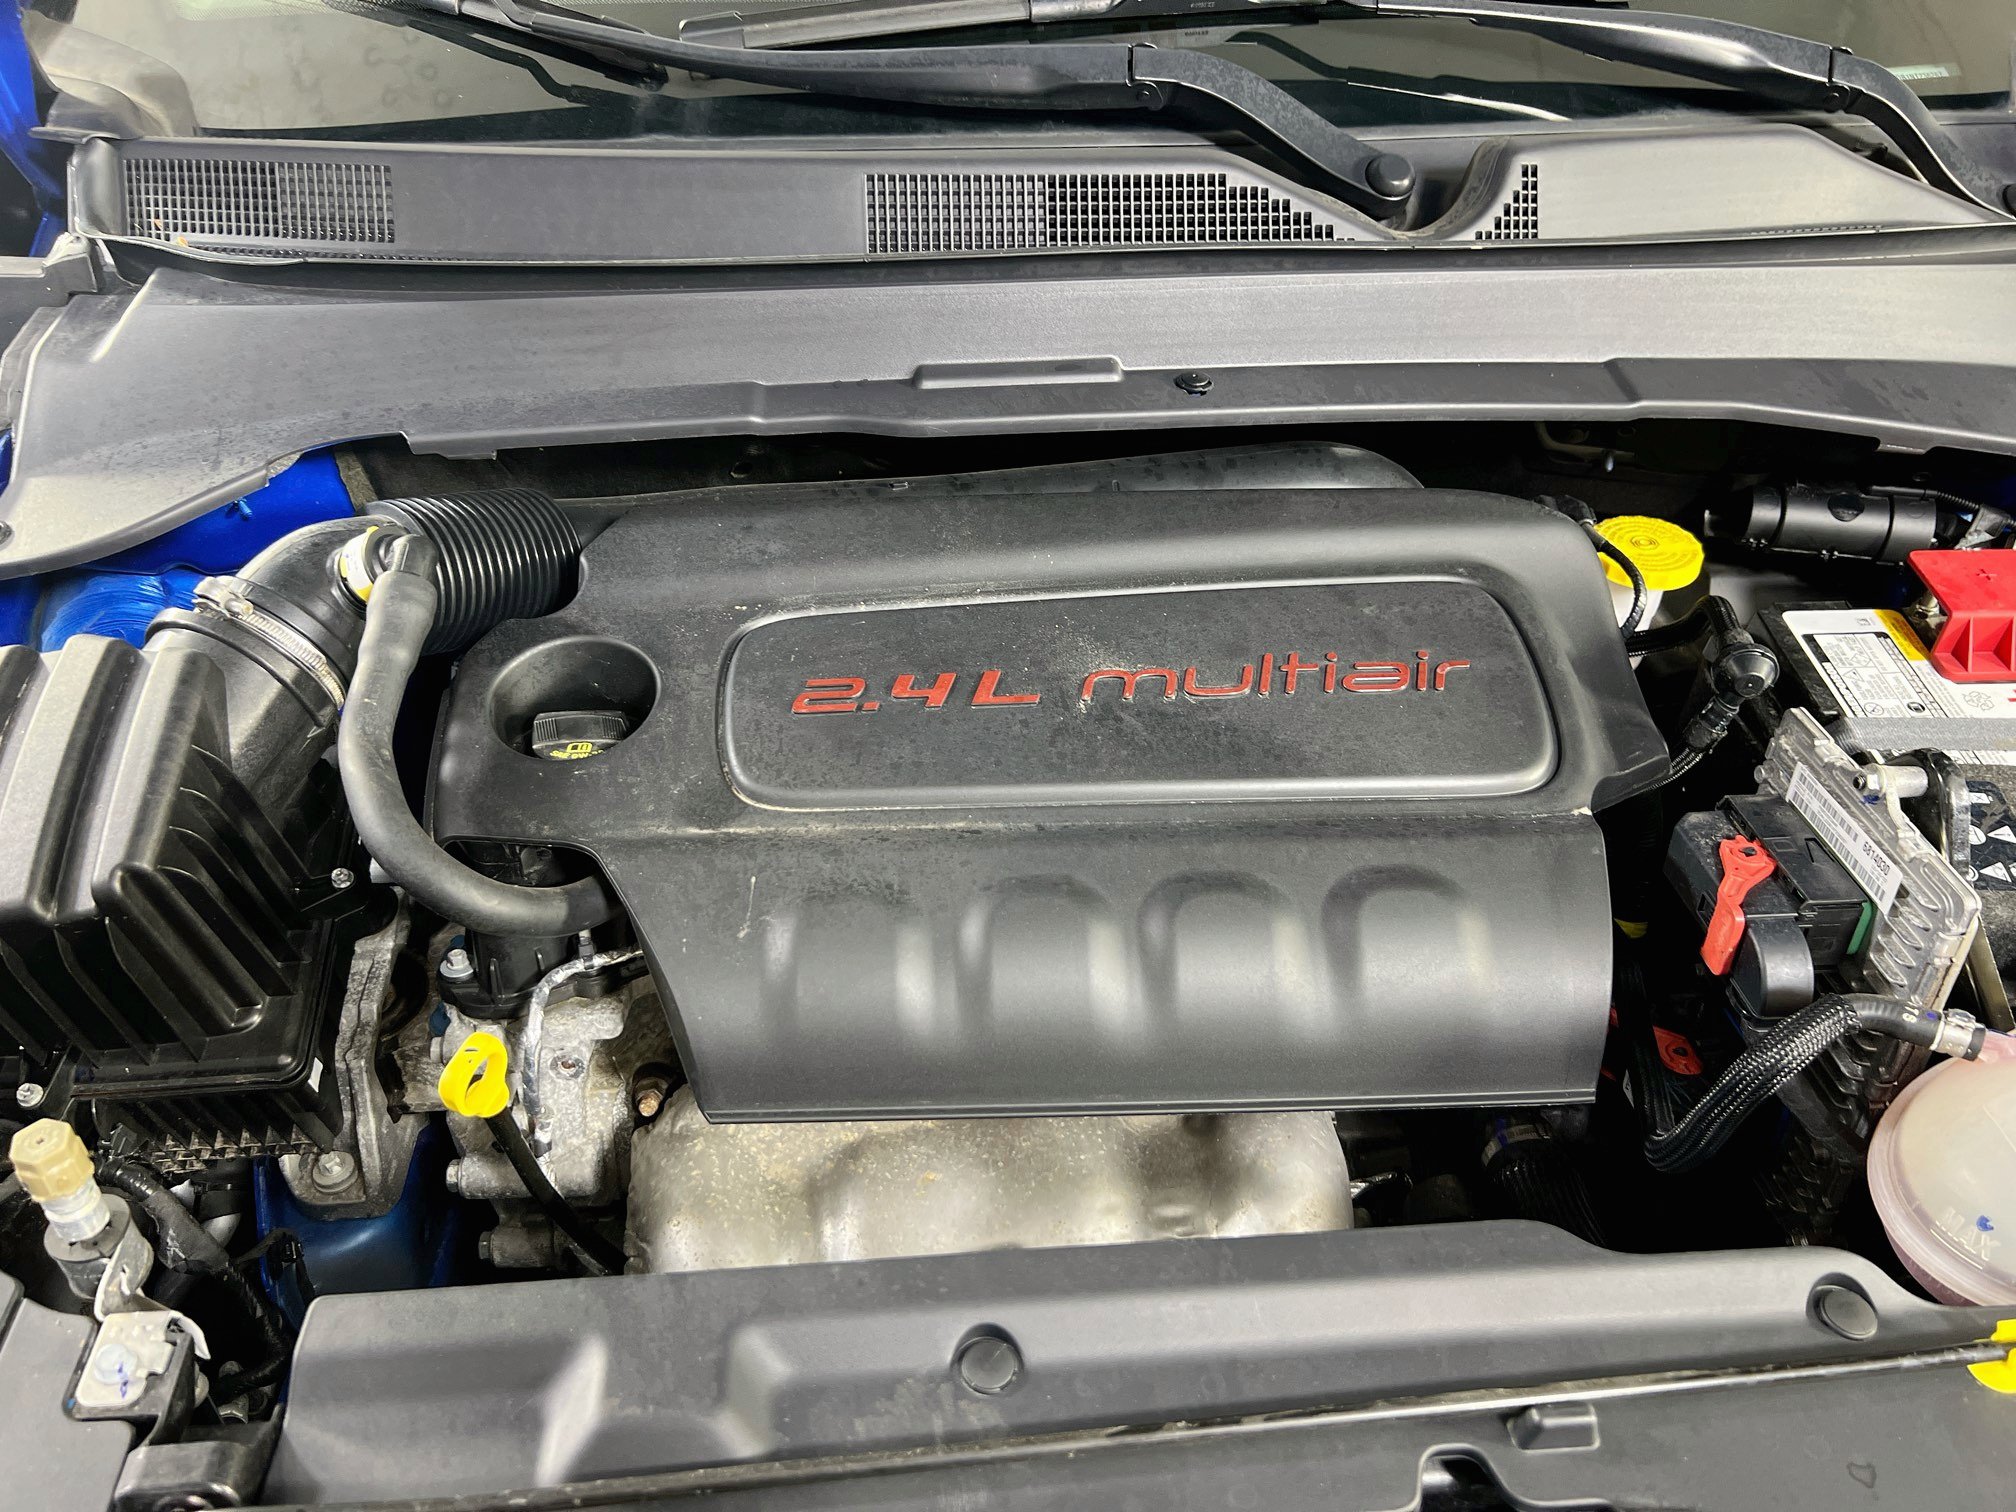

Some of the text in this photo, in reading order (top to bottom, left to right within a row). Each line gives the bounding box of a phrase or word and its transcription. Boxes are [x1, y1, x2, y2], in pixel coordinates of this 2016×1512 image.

[791, 650, 1471, 714] 2.4L multiair
[1936, 1206, 2001, 1261] MAX
